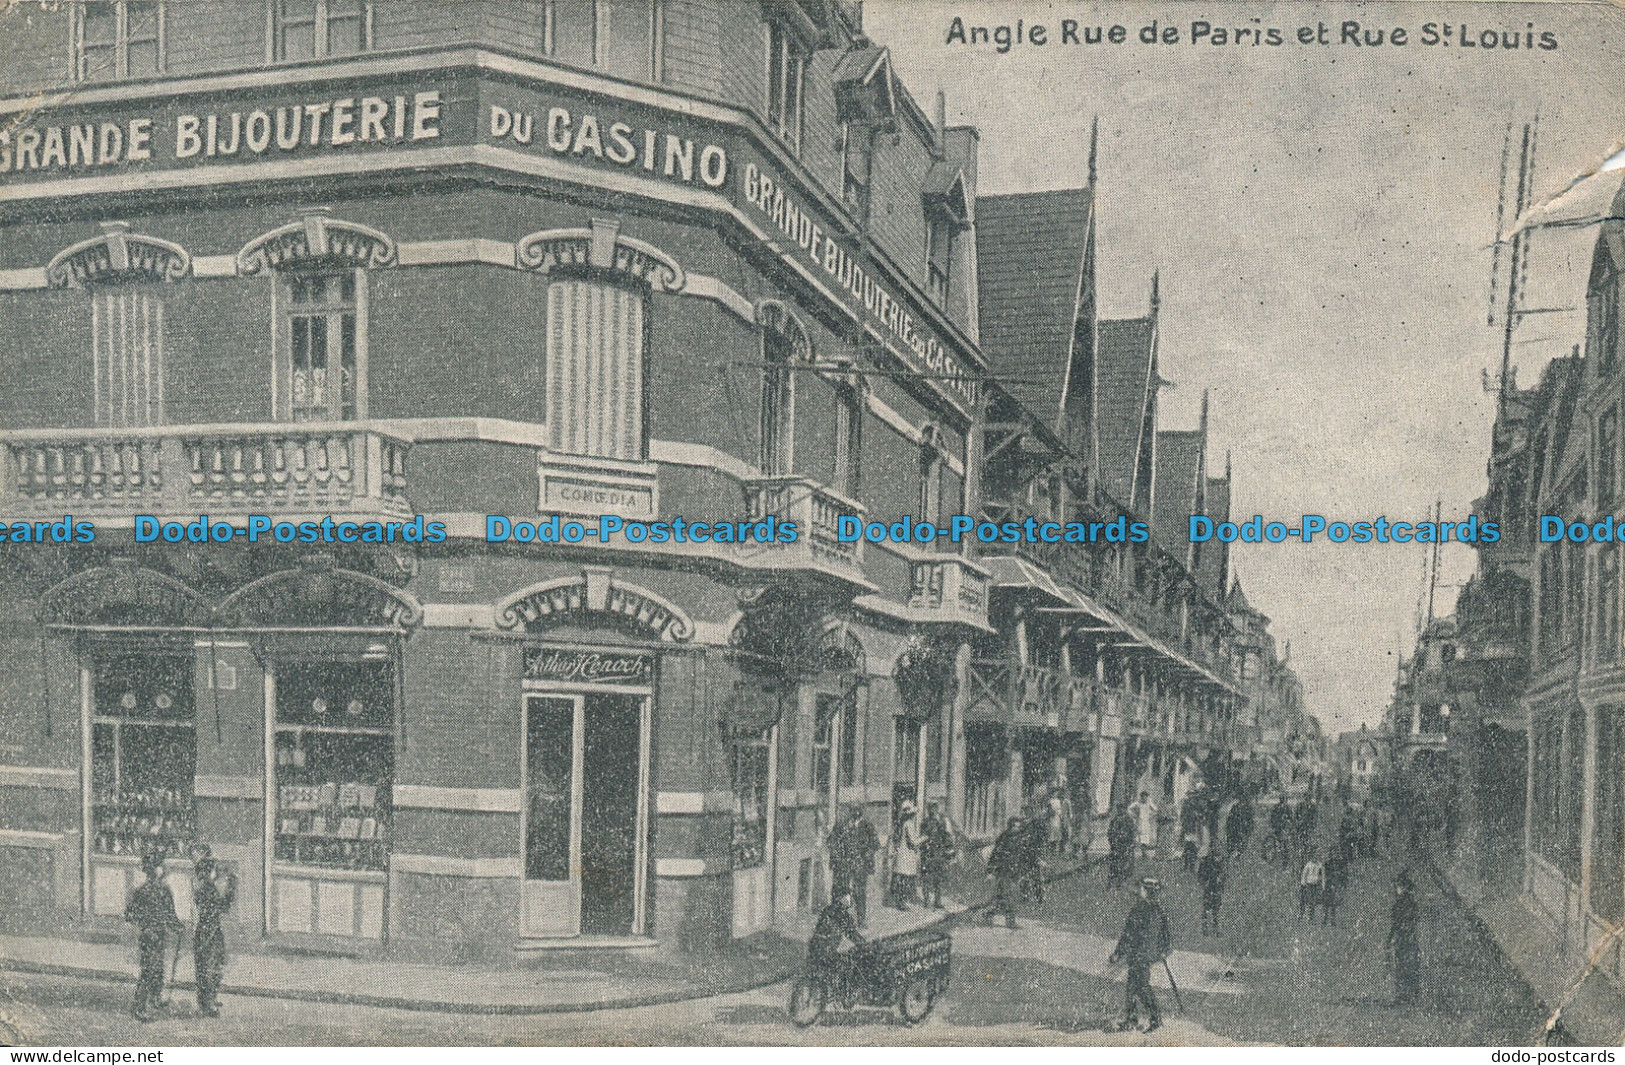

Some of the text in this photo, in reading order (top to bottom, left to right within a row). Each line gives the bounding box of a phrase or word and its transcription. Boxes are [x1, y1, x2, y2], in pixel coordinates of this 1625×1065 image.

[176, 91, 441, 158] BIJOUTERIE
[490, 104, 727, 187] DU CASINO
[744, 162, 823, 265] GRANDE
[824, 236, 914, 344] BIJOUTERIE
